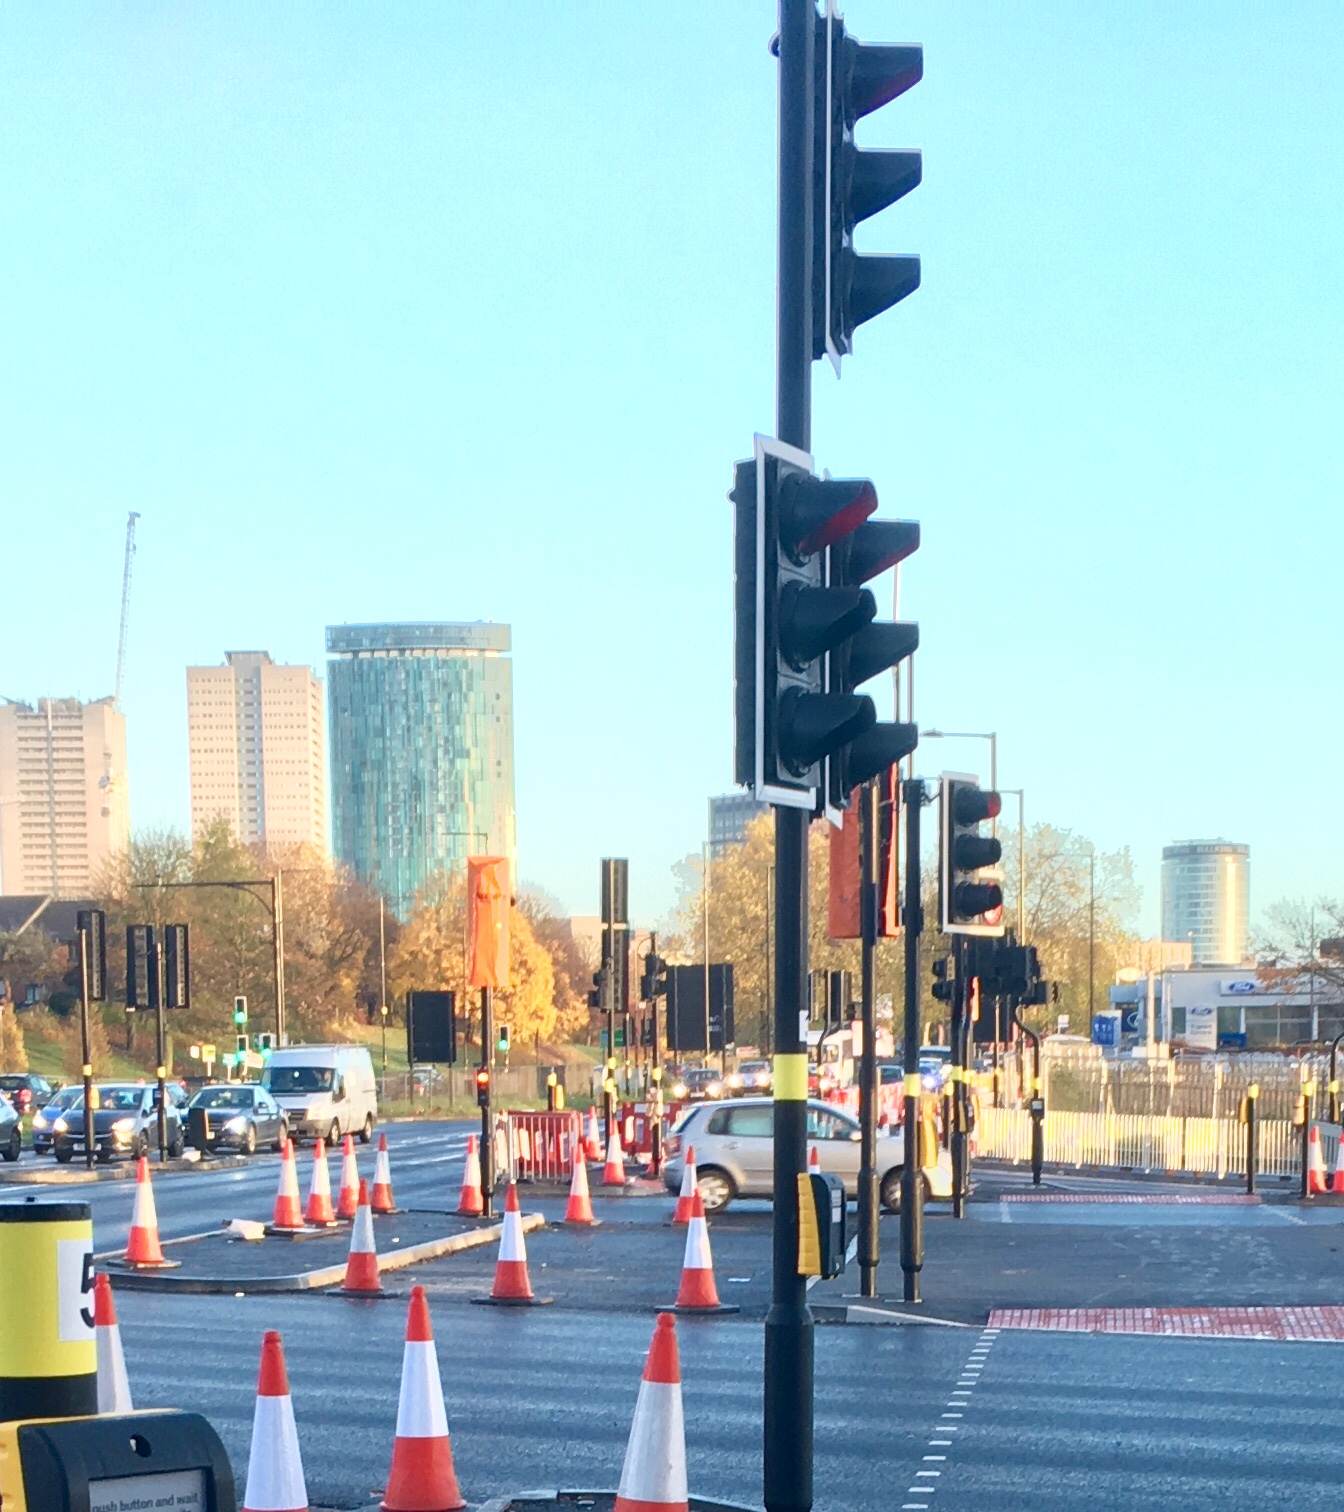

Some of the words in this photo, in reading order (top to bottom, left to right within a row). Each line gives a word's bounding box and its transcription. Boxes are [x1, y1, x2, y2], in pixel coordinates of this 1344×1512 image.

[119, 1498, 153, 1512] button
[155, 1494, 174, 1507] and
[176, 1492, 199, 1505] wait
